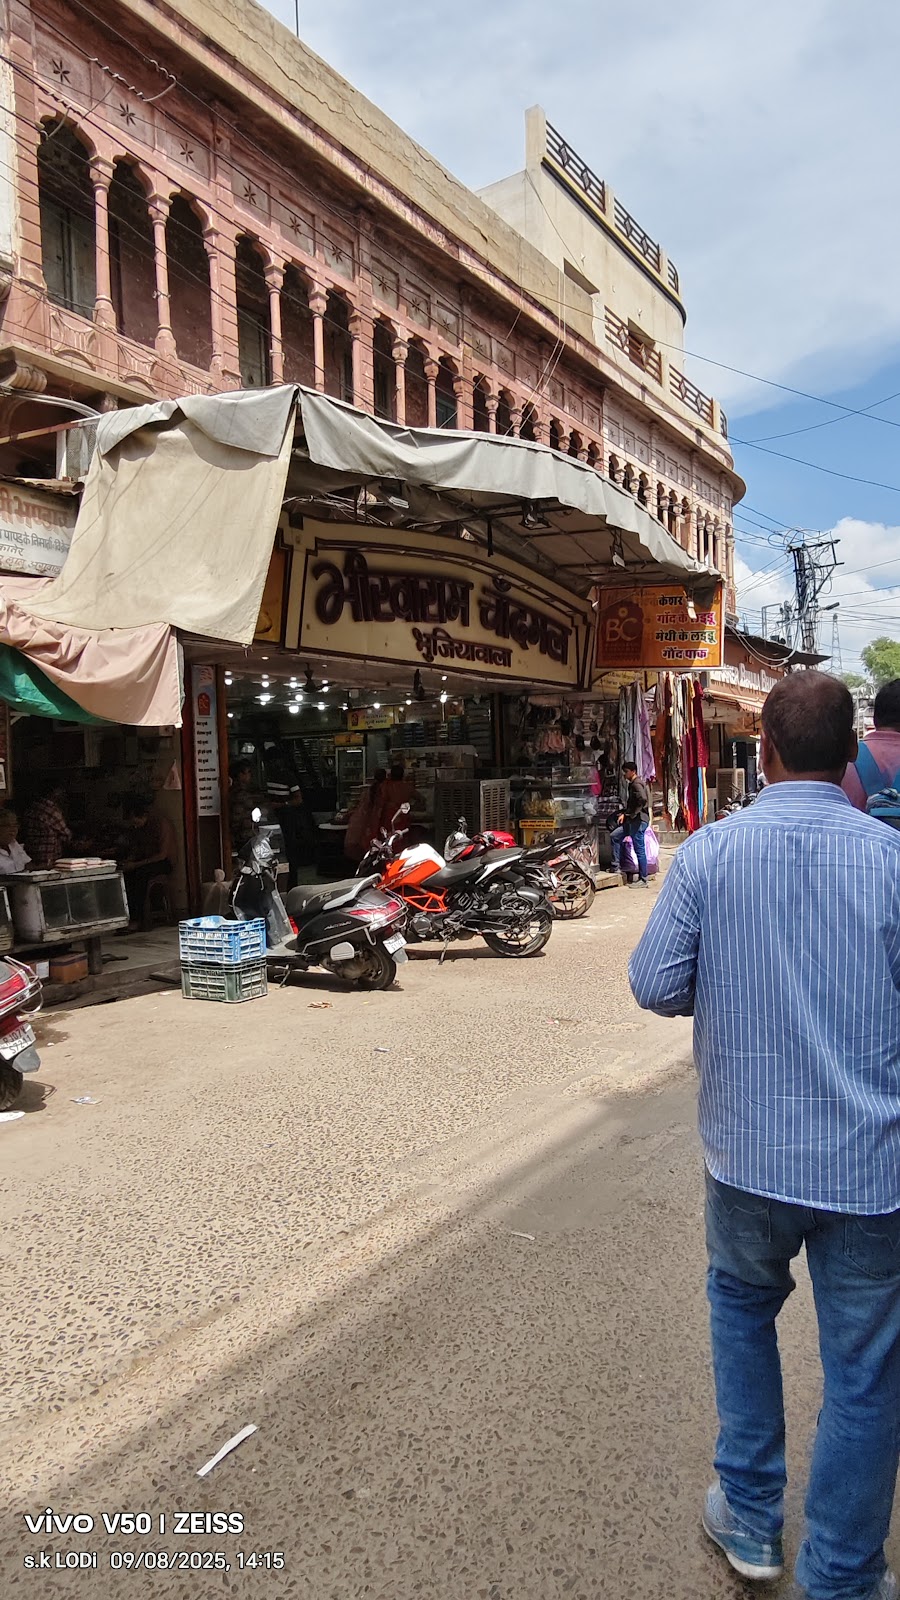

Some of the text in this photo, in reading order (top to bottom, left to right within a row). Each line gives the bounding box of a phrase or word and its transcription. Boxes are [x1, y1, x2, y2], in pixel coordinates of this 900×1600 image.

[678, 611, 688, 623] के
[605, 618, 639, 641] BC
[655, 629, 677, 642] मेथी
[678, 629, 688, 641] के
[412, 627, 513, 668] भुजियावाला
[684, 649, 708, 659] पाक
